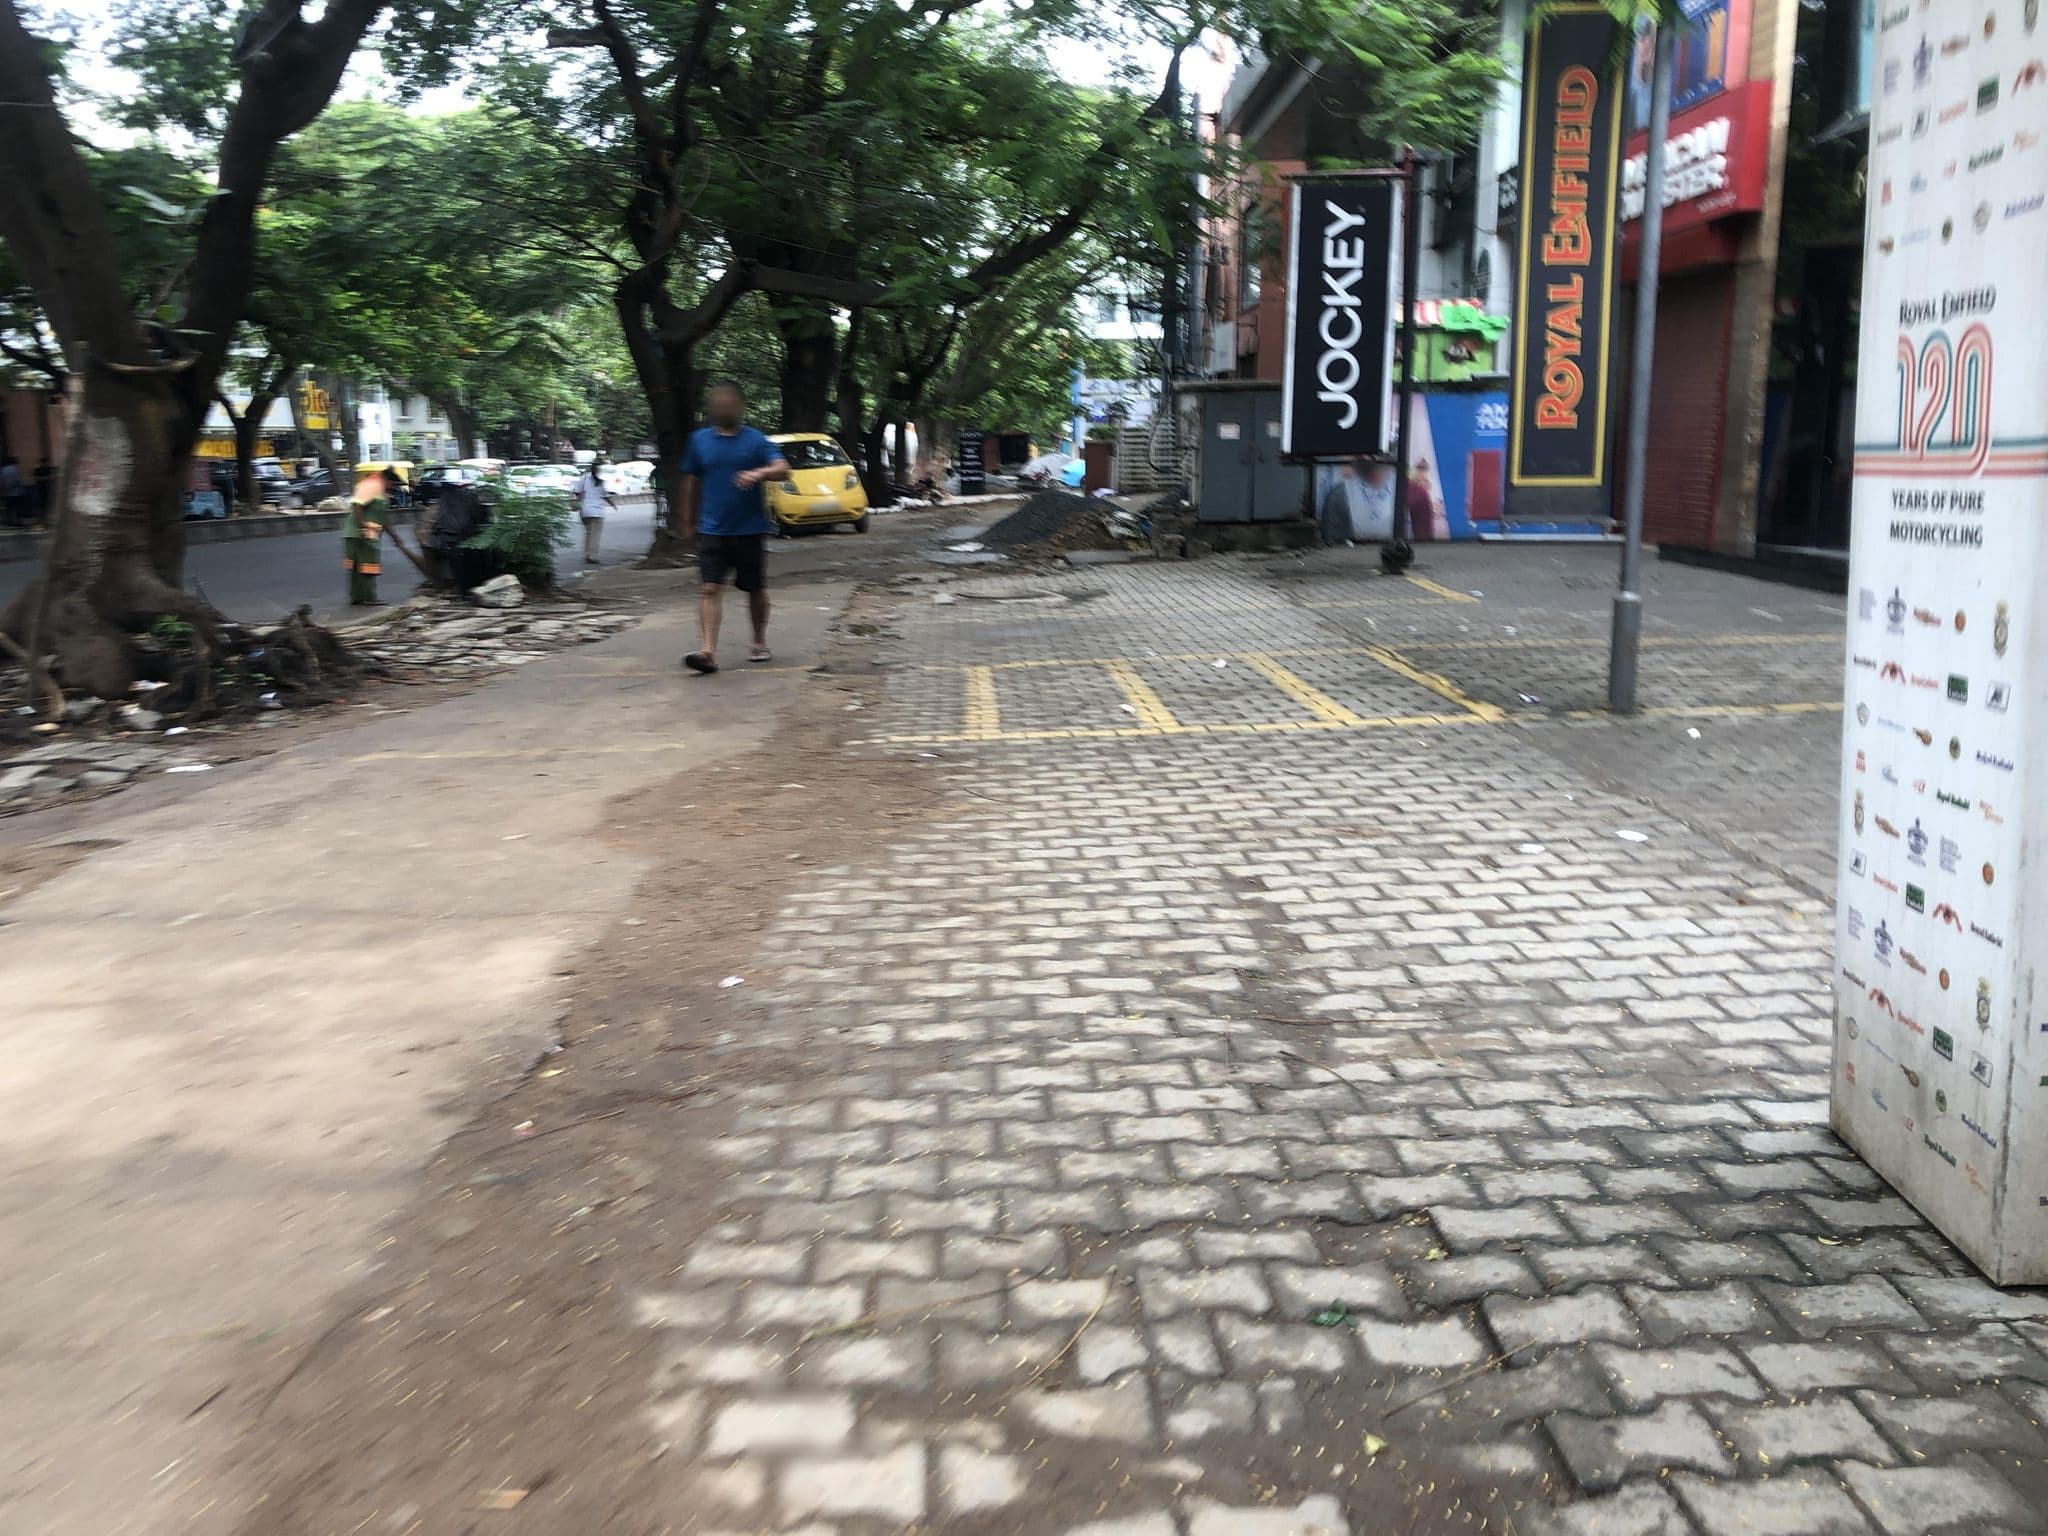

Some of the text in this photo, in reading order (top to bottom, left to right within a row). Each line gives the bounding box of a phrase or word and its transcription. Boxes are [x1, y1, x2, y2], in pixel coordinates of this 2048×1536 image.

[1535, 64, 1599, 429] ROYAL ENFIELD
[1316, 199, 1366, 430] JOCKEY
[1899, 285, 1996, 329] ROYAL ENFIELD
[1897, 322, 1994, 470] 120
[1889, 519, 1983, 549] MOTORCYCLING
[1892, 488, 1985, 515] YEARS OF PURE
